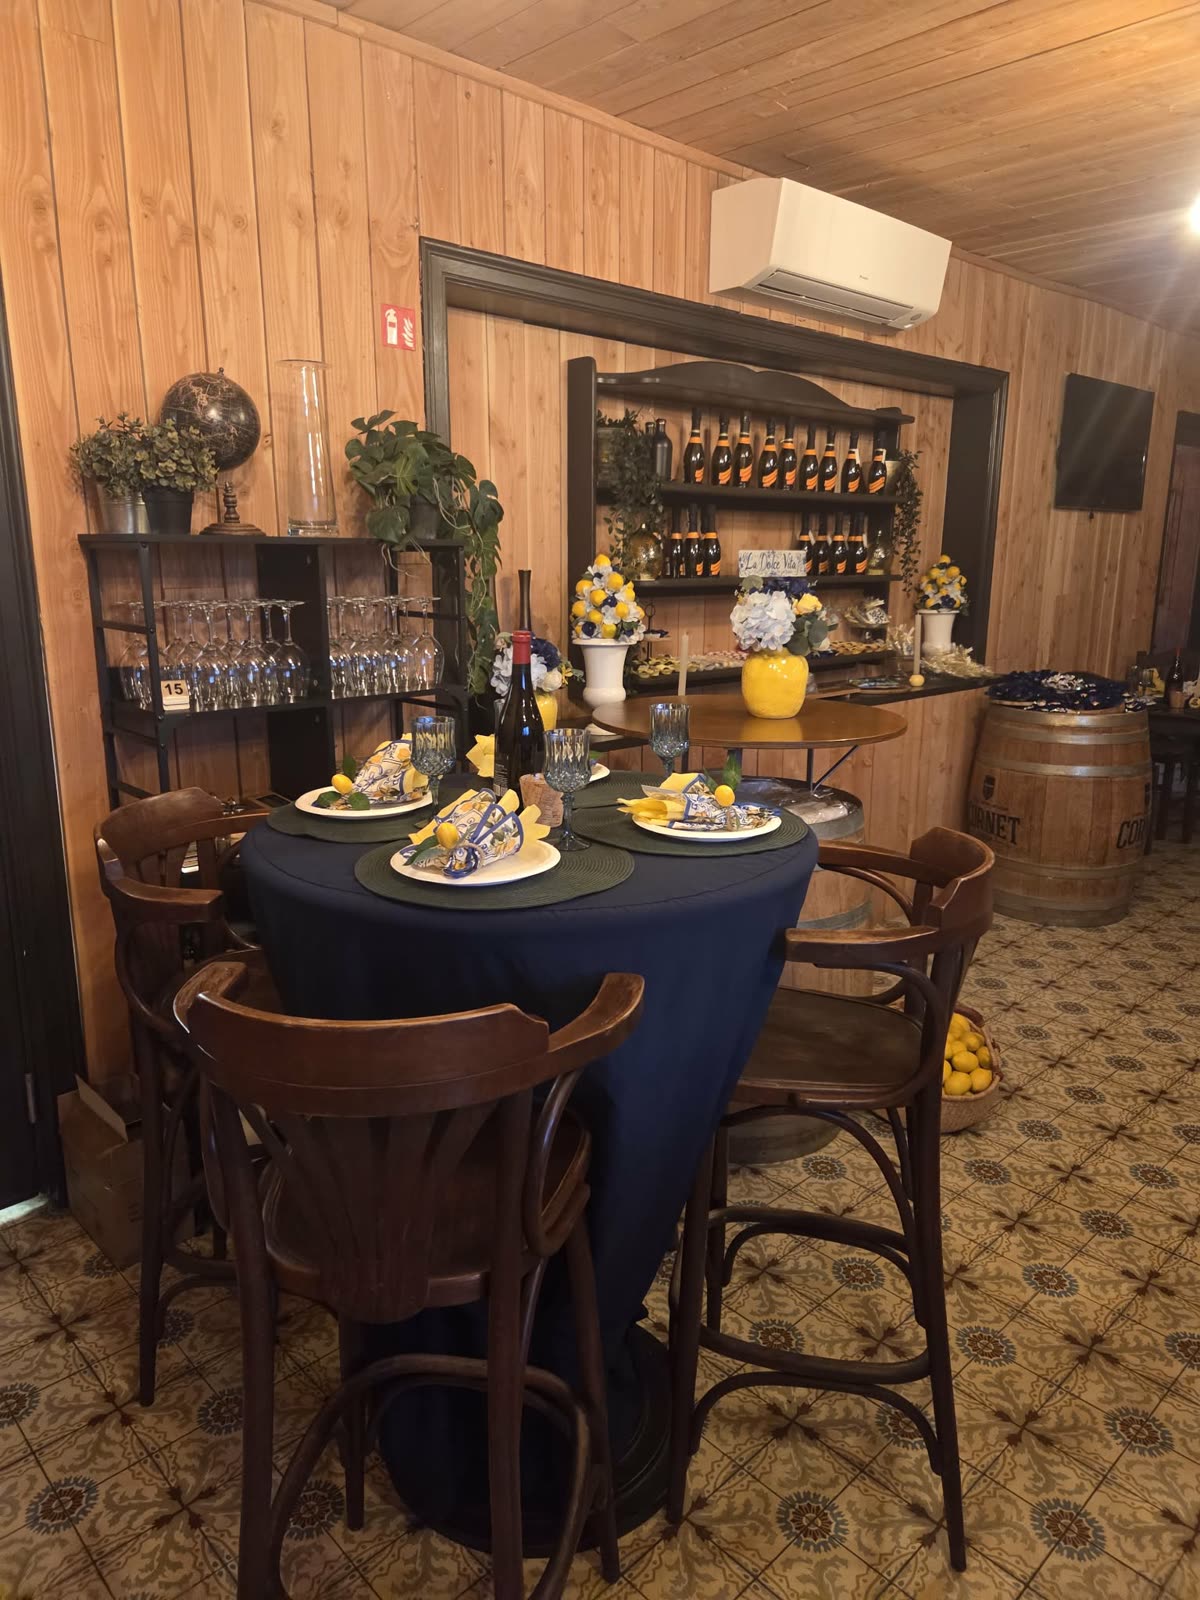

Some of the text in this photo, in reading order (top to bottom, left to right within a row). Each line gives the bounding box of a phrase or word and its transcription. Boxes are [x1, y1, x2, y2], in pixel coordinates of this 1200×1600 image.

[745, 551, 797, 571] La Dolce Vita
[165, 683, 183, 695] 15
